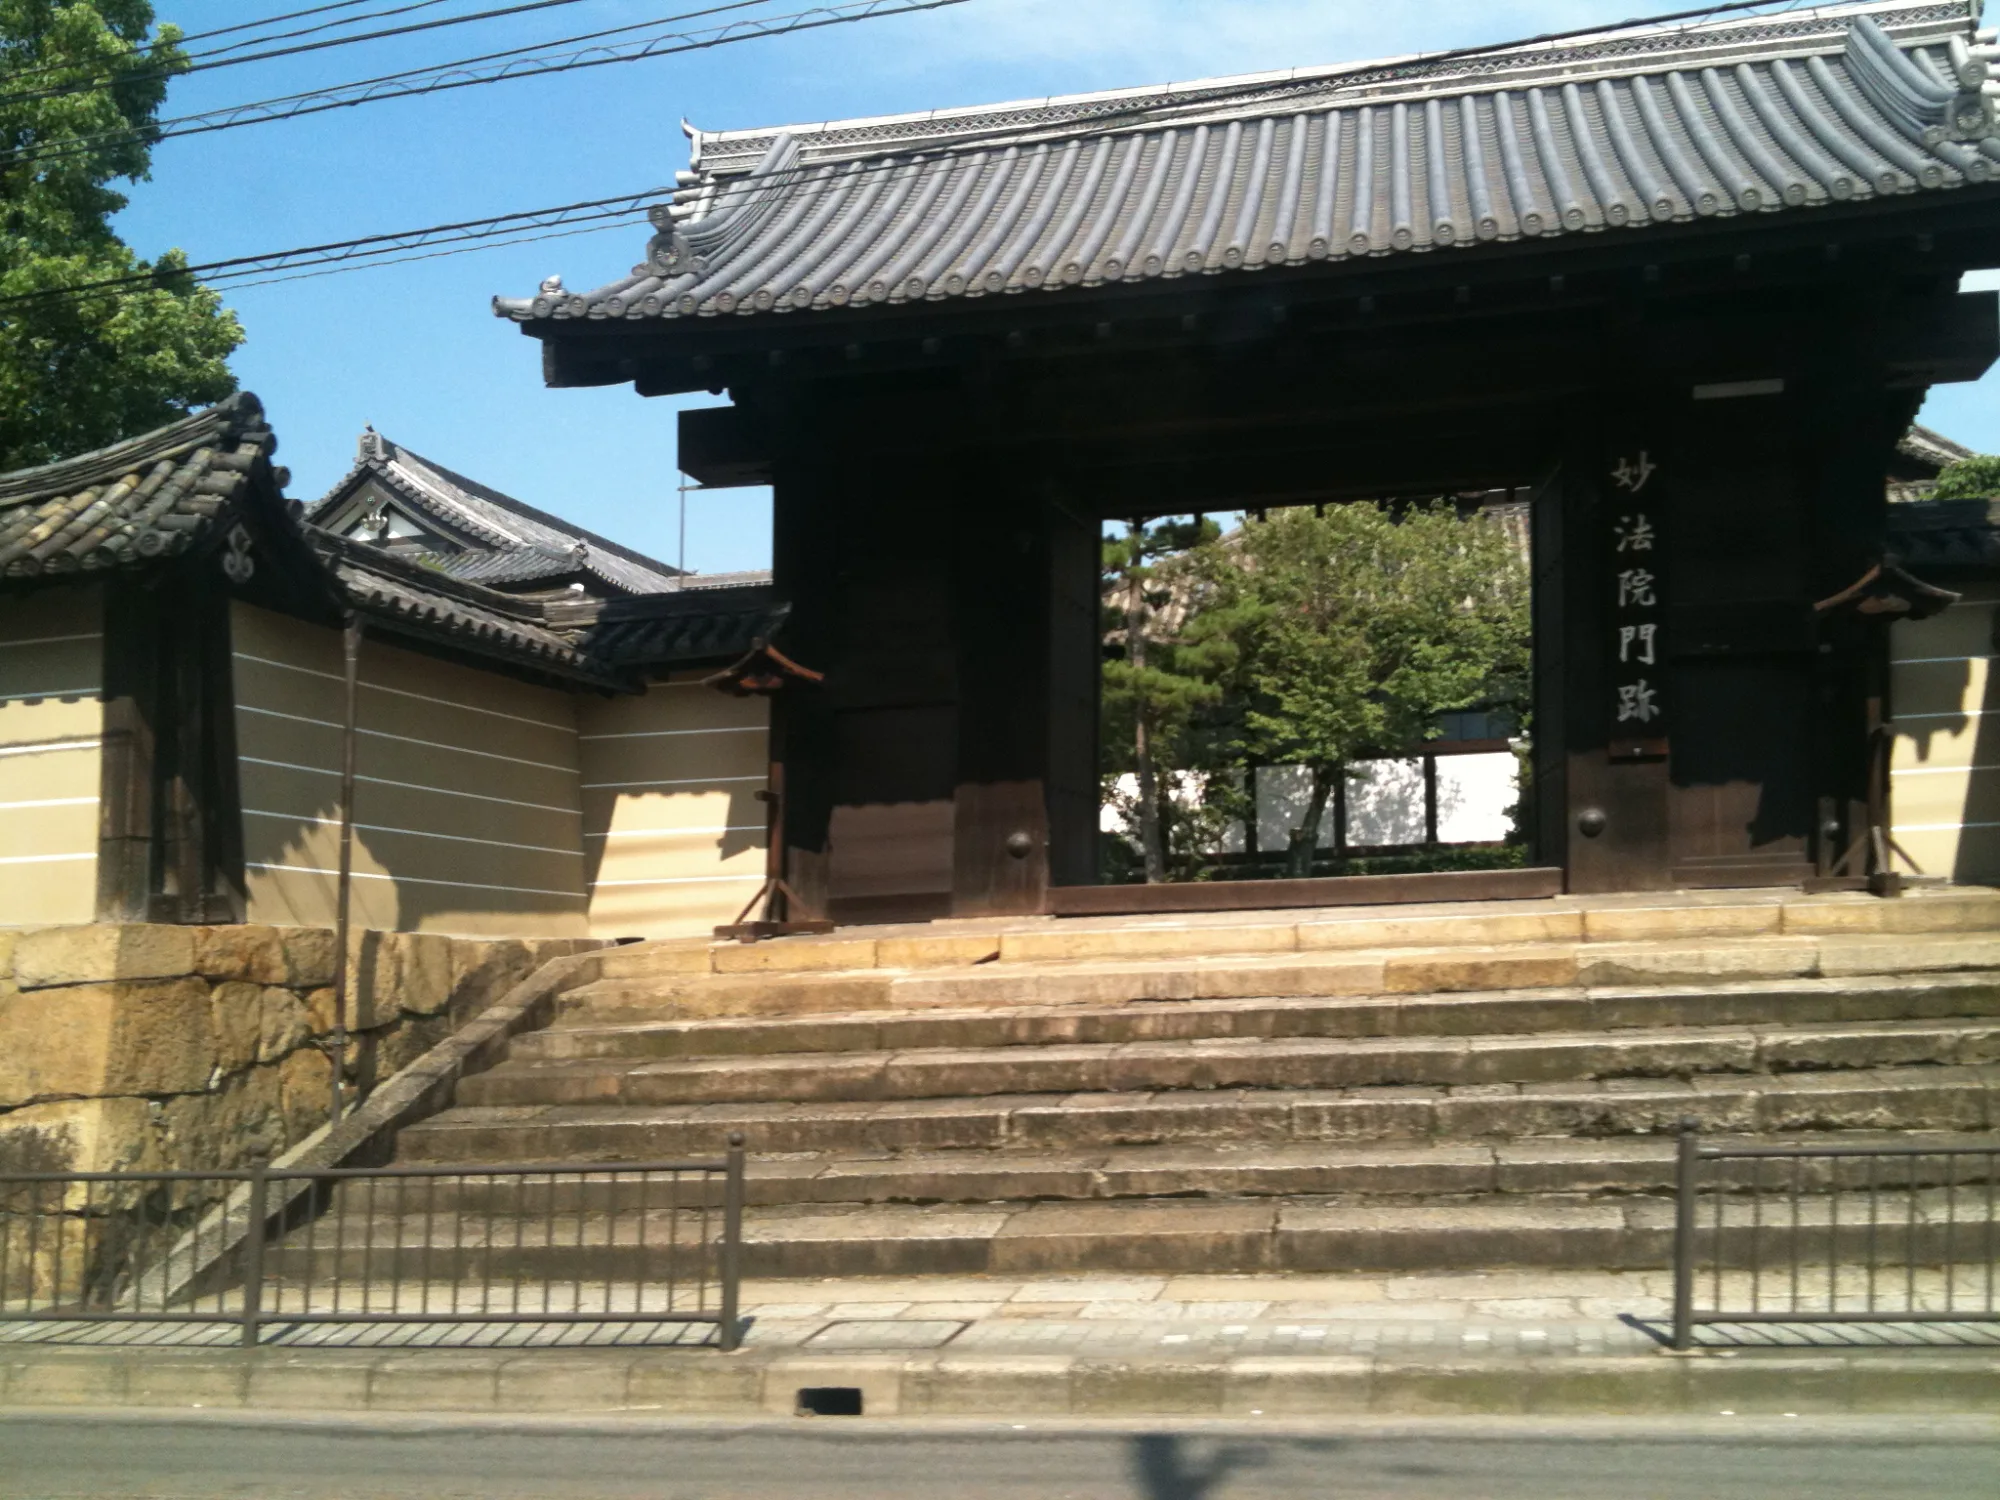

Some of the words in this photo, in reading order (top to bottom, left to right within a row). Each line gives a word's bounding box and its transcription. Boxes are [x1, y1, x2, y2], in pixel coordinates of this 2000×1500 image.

[1610, 450, 1660, 723] 妙法院門跡
